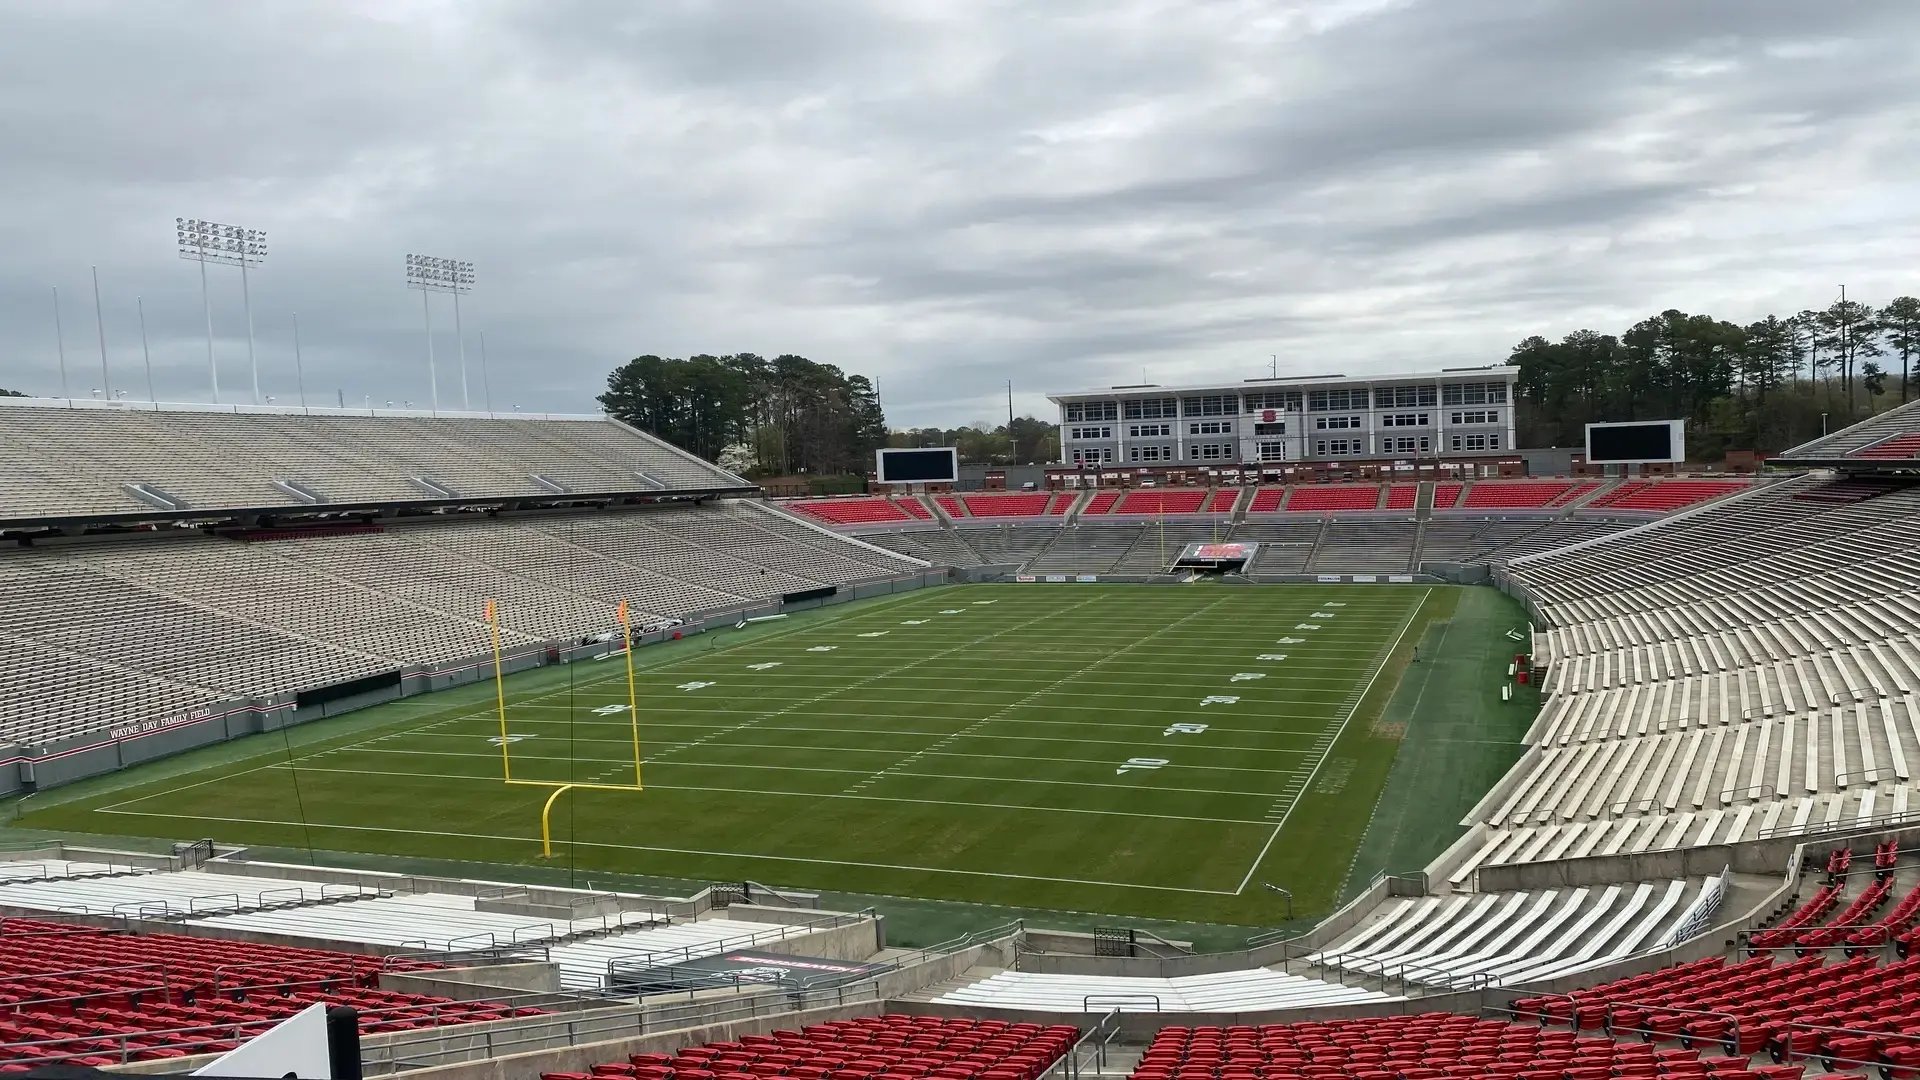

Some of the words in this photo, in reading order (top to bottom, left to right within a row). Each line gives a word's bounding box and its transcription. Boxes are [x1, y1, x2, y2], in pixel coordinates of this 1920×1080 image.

[109, 725, 139, 739] WAYNE
[142, 721, 158, 731] DAY
[160, 713, 188, 727] FAMILY
[190, 707, 210, 719] FIELD
[1165, 723, 1209, 734] 20
[1120, 757, 1170, 770] 10
